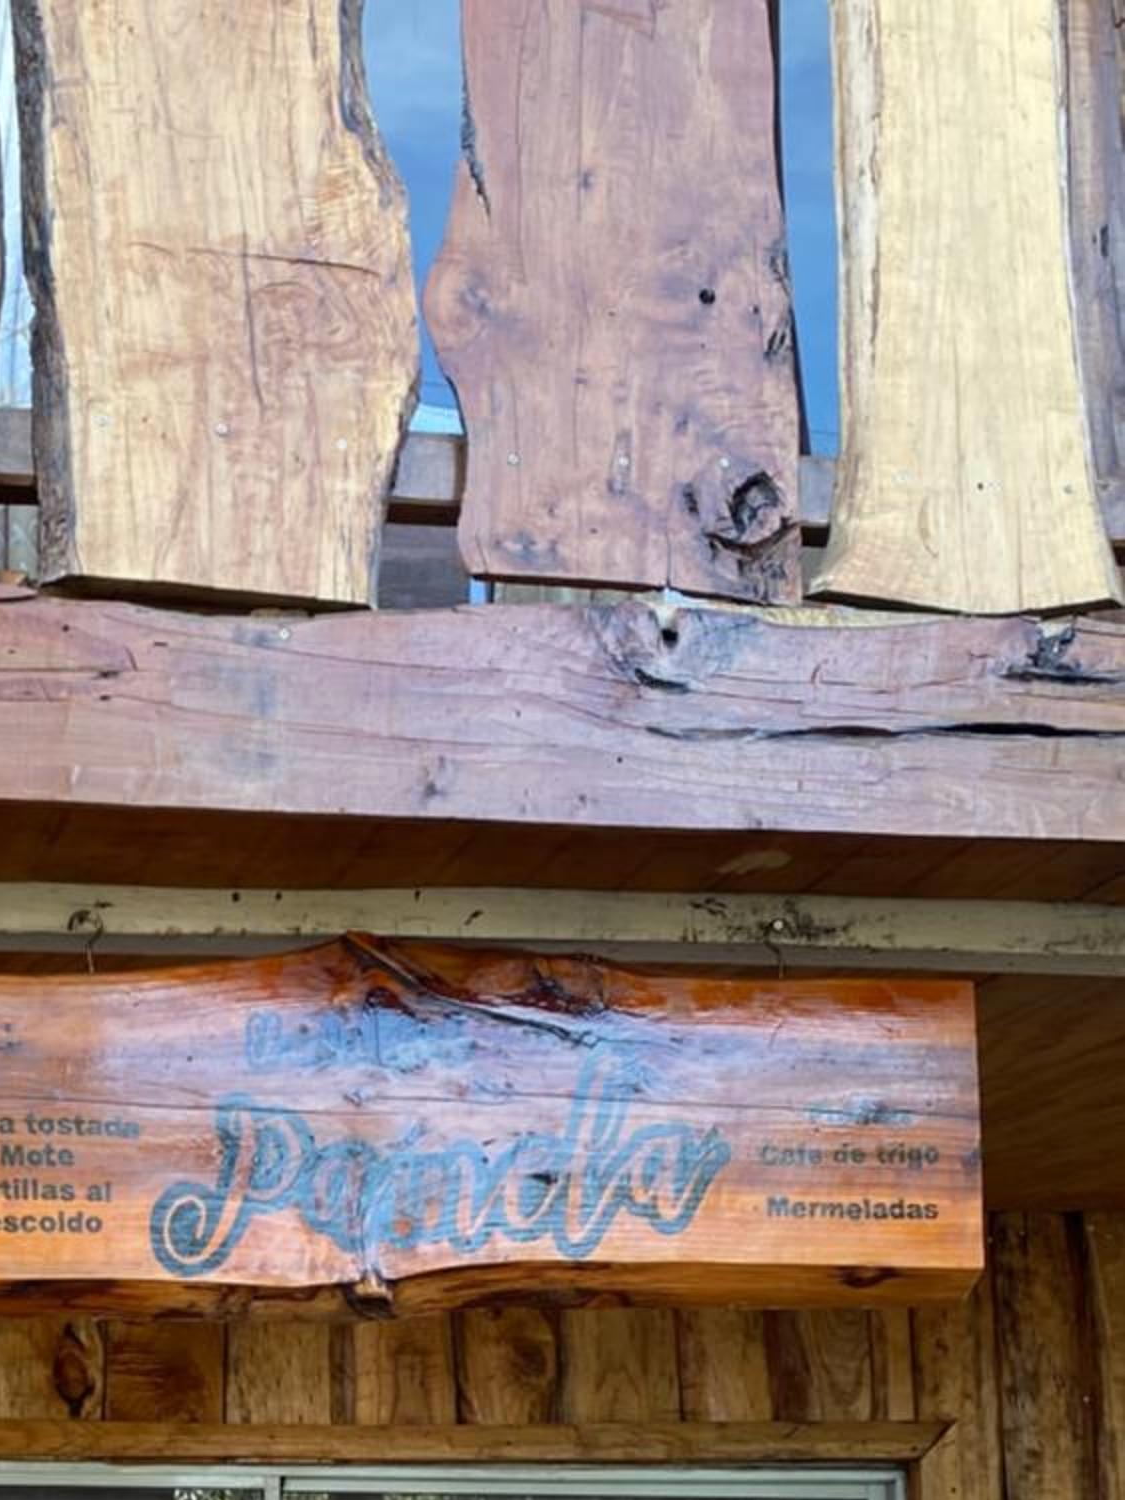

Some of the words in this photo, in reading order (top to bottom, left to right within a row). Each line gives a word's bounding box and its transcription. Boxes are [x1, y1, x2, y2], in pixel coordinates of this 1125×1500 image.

[0, 1144, 75, 1167] Mote
[833, 1144, 866, 1165] de
[878, 1144, 940, 1170] trigo
[85, 1181, 111, 1202] al
[766, 1197, 939, 1220] Mermeladas
